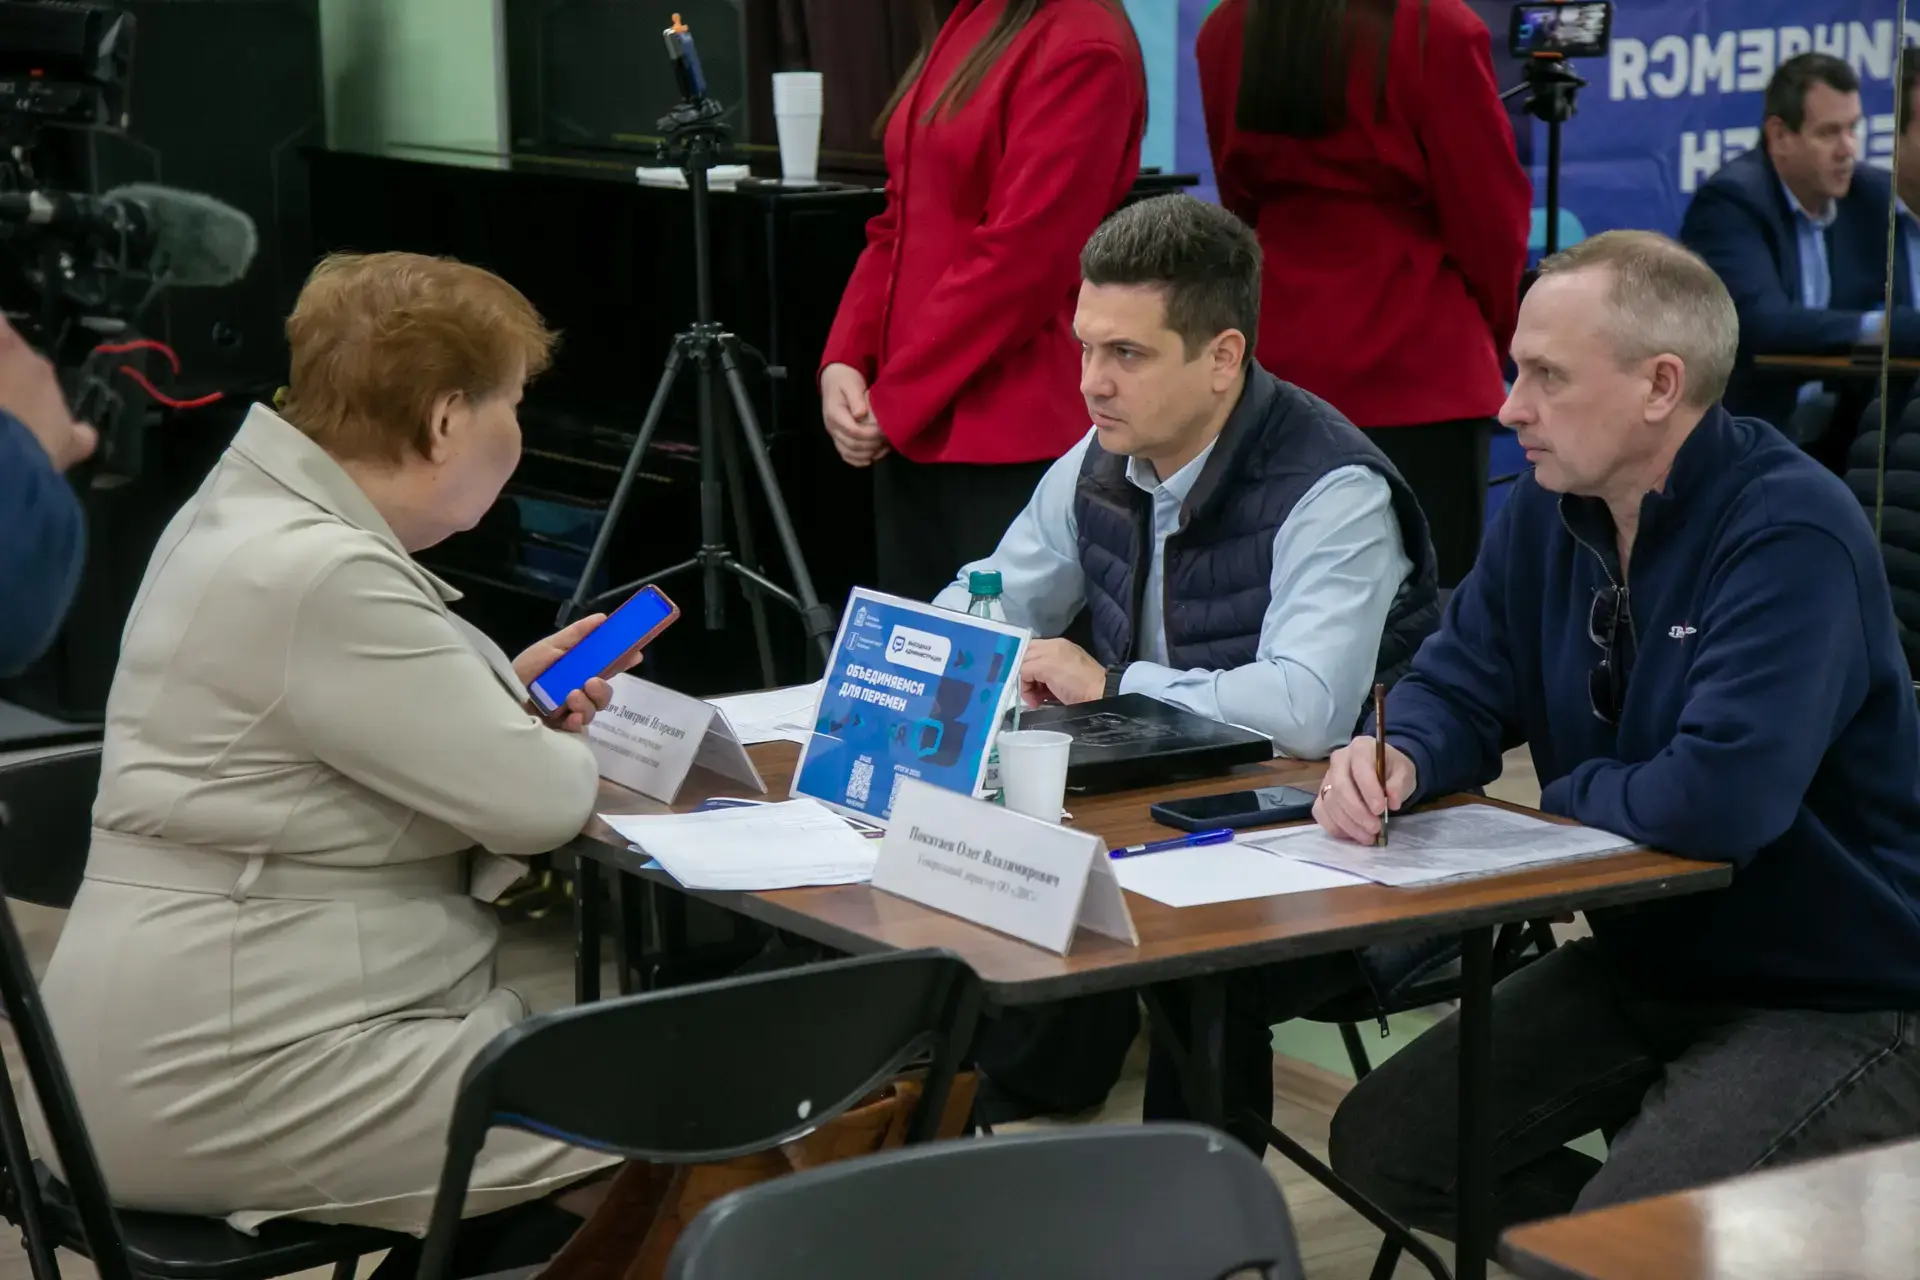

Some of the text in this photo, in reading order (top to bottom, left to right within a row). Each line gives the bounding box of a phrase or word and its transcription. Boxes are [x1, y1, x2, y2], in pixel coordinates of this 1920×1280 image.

[838, 682, 907, 712] ДЛЯ ПЕРЕМЕН
[846, 663, 925, 697] ОБЪЕДИНЯЕМСЯ
[616, 705, 651, 726] Дмитрий
[650, 716, 686, 740] Игоревич
[957, 840, 981, 861] Олег
[982, 850, 1060, 889] Владимирович
